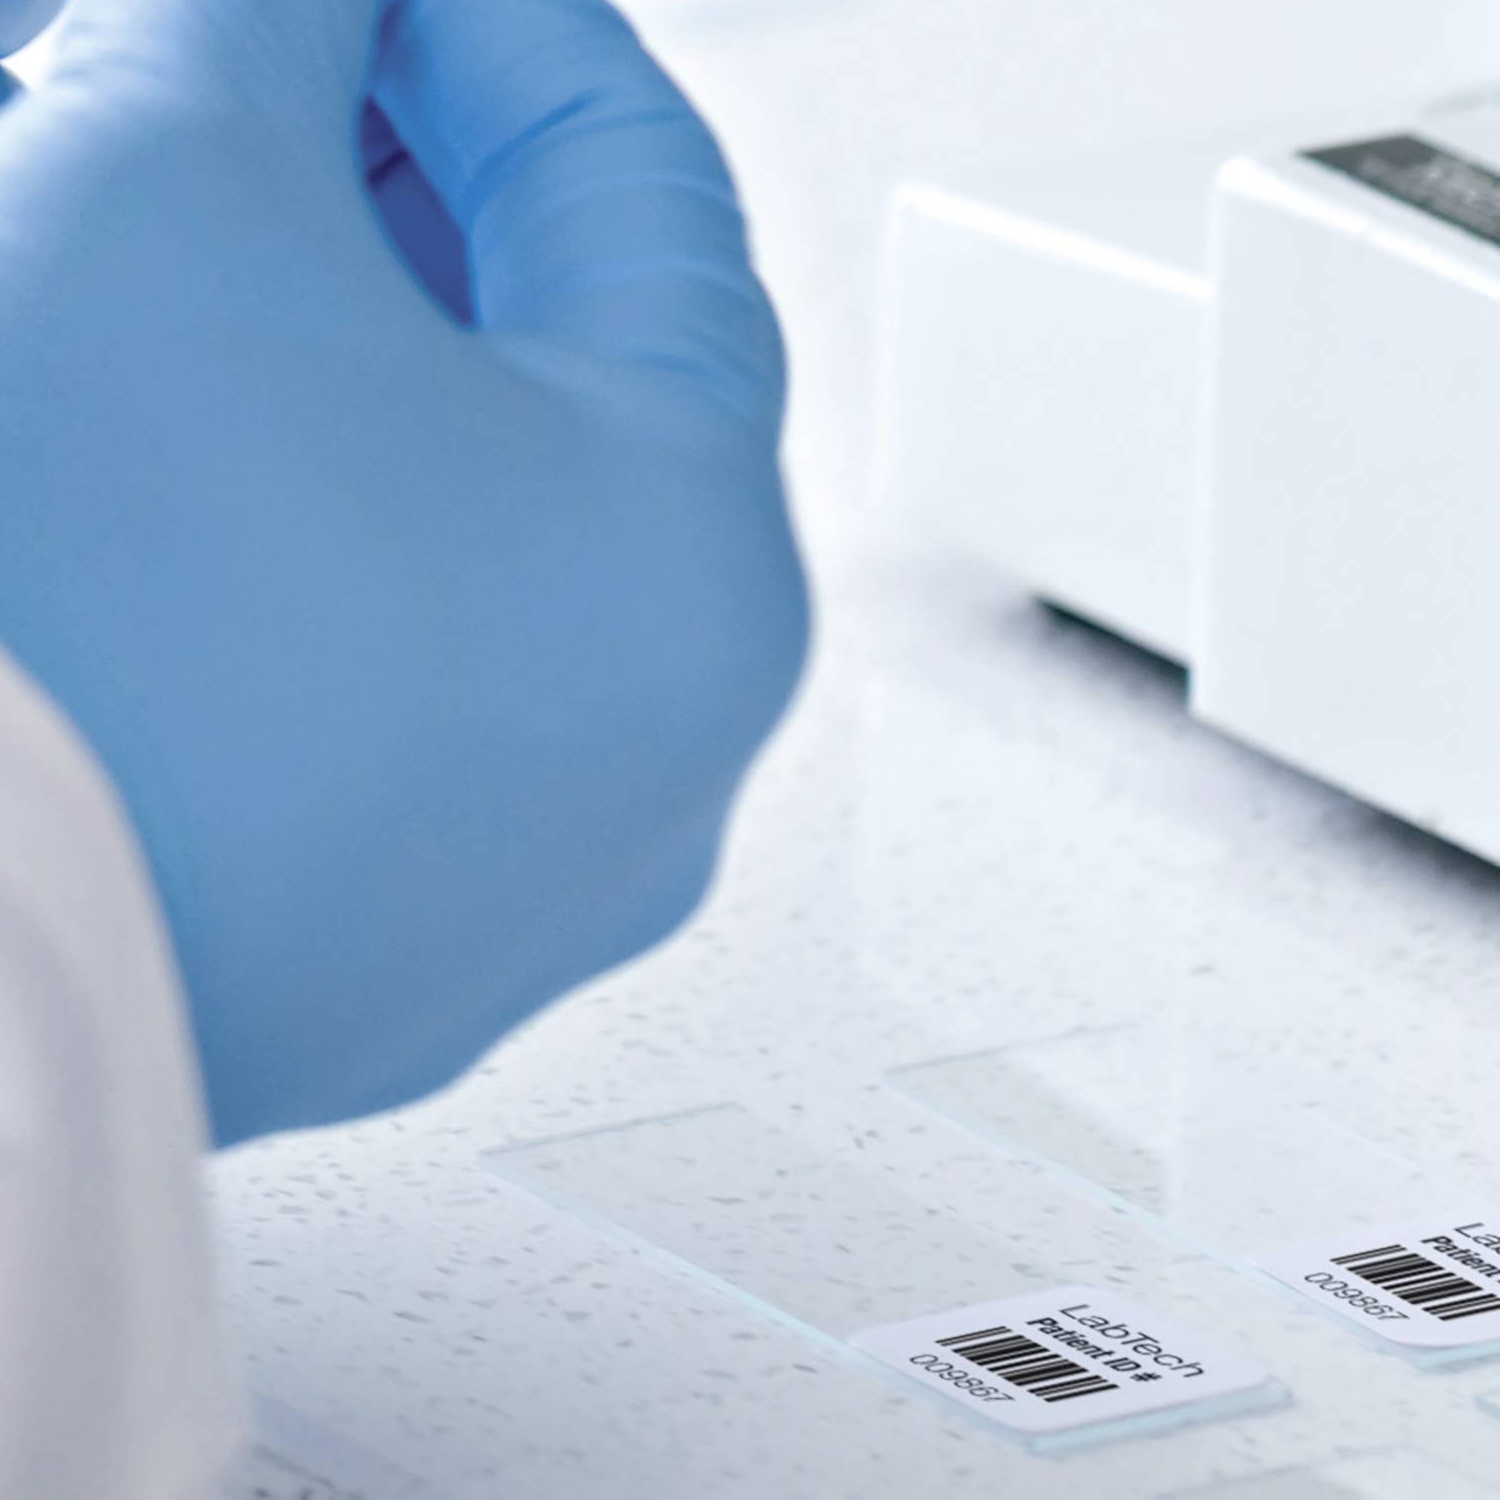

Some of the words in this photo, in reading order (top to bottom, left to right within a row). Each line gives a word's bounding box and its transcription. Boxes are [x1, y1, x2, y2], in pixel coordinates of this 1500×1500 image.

[1304, 1271, 1411, 1321] 009867
[1025, 1317, 1116, 1360] Patient
[1102, 1357, 1143, 1373] ID
[1129, 1371, 1163, 1383] #
[1059, 1304, 1205, 1379] LabTech
[909, 1353, 1016, 1403] 009867
